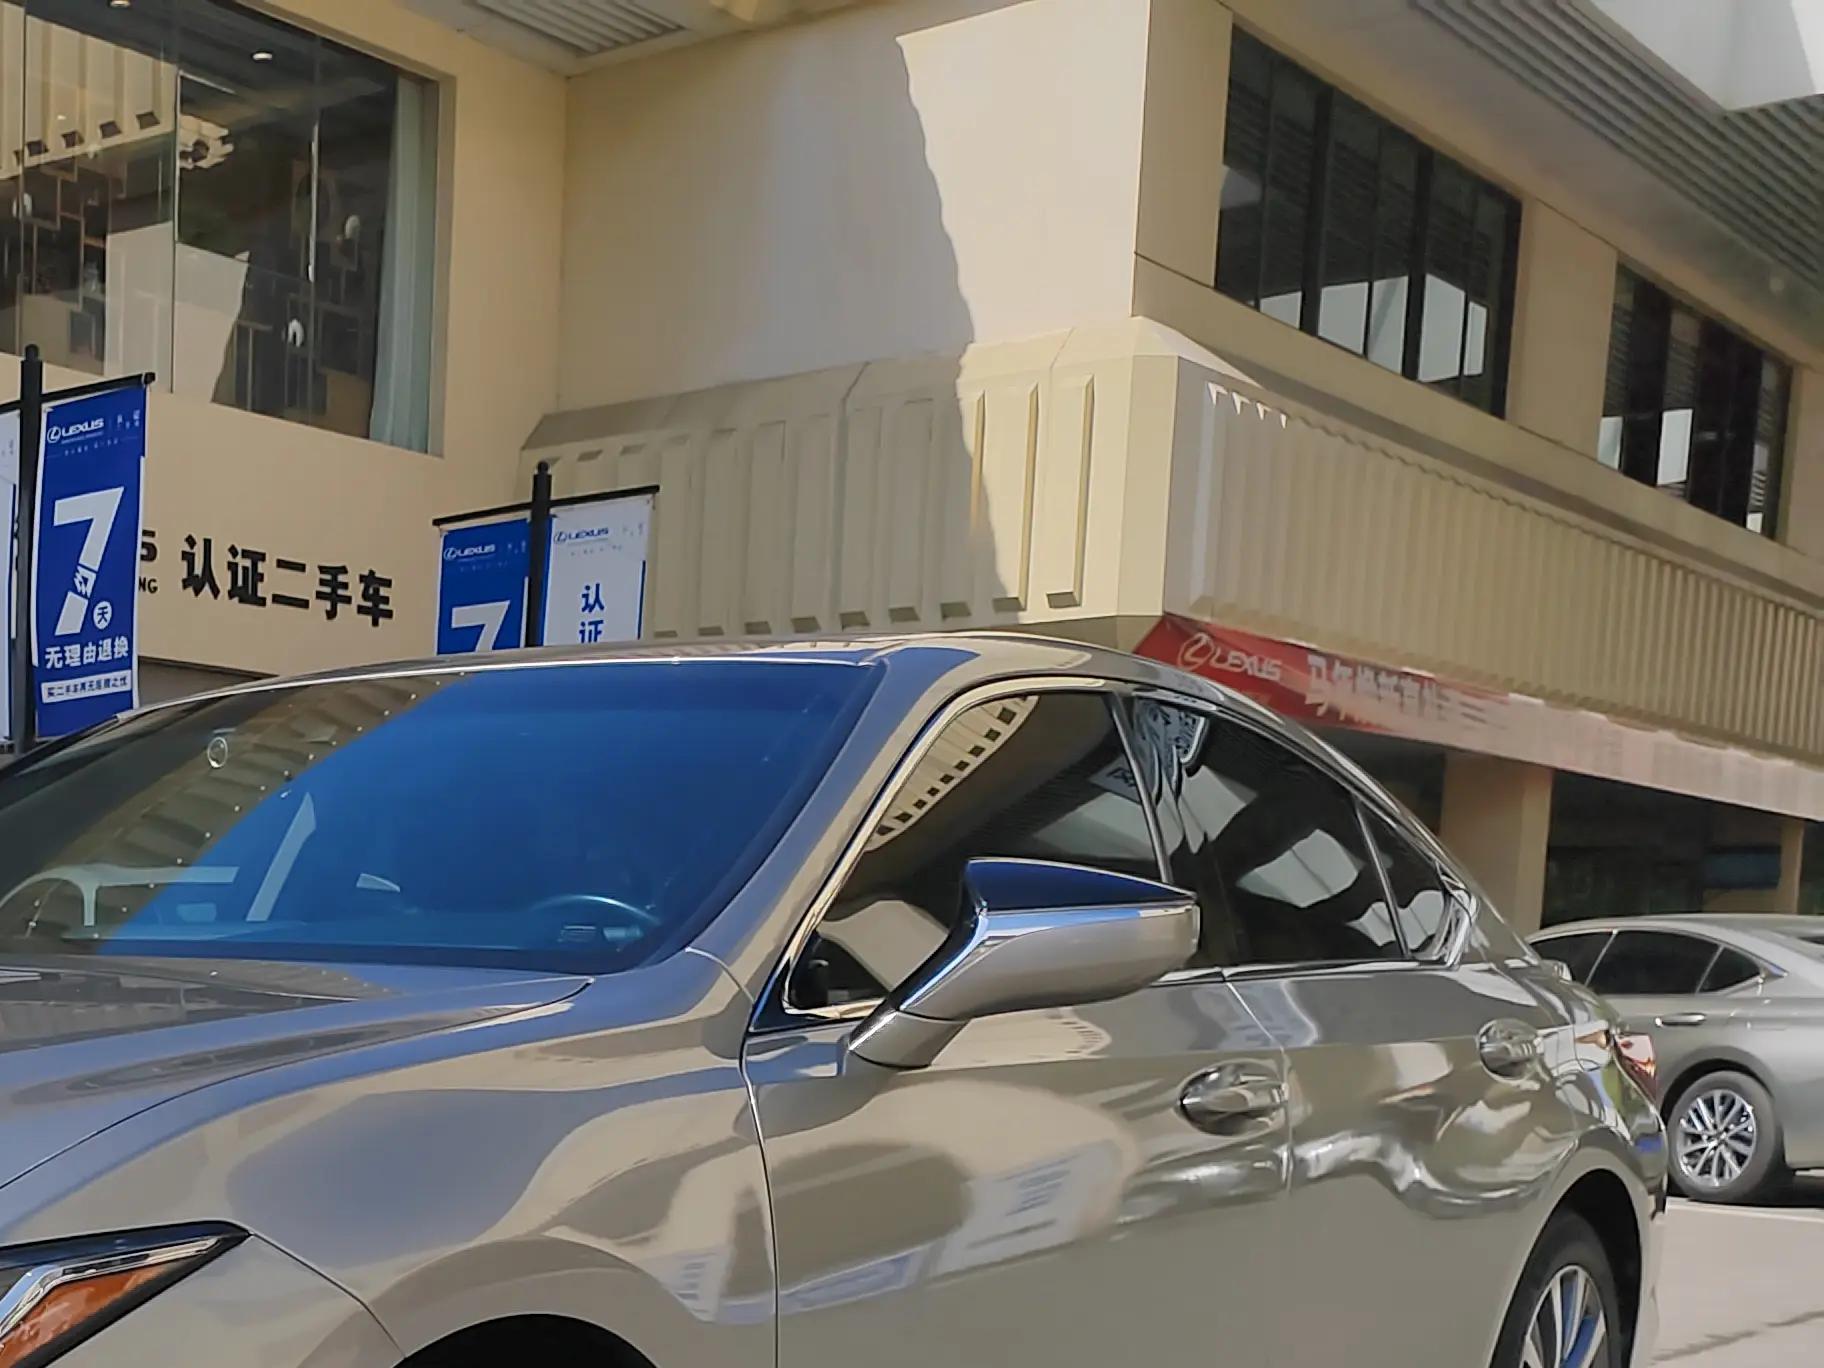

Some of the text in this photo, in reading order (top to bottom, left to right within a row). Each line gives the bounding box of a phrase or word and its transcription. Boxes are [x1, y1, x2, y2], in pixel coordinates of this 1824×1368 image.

[61, 418, 105, 436] LEXUS
[457, 543, 496, 558] LEXUS
[568, 527, 609, 541] LEXUS
[53, 486, 125, 636] 7
[96, 605, 109, 625] 天
[181, 534, 393, 627] 认证二手车
[45, 635, 129, 669] 无理由退换
[1209, 647, 1282, 682] LEXUS
